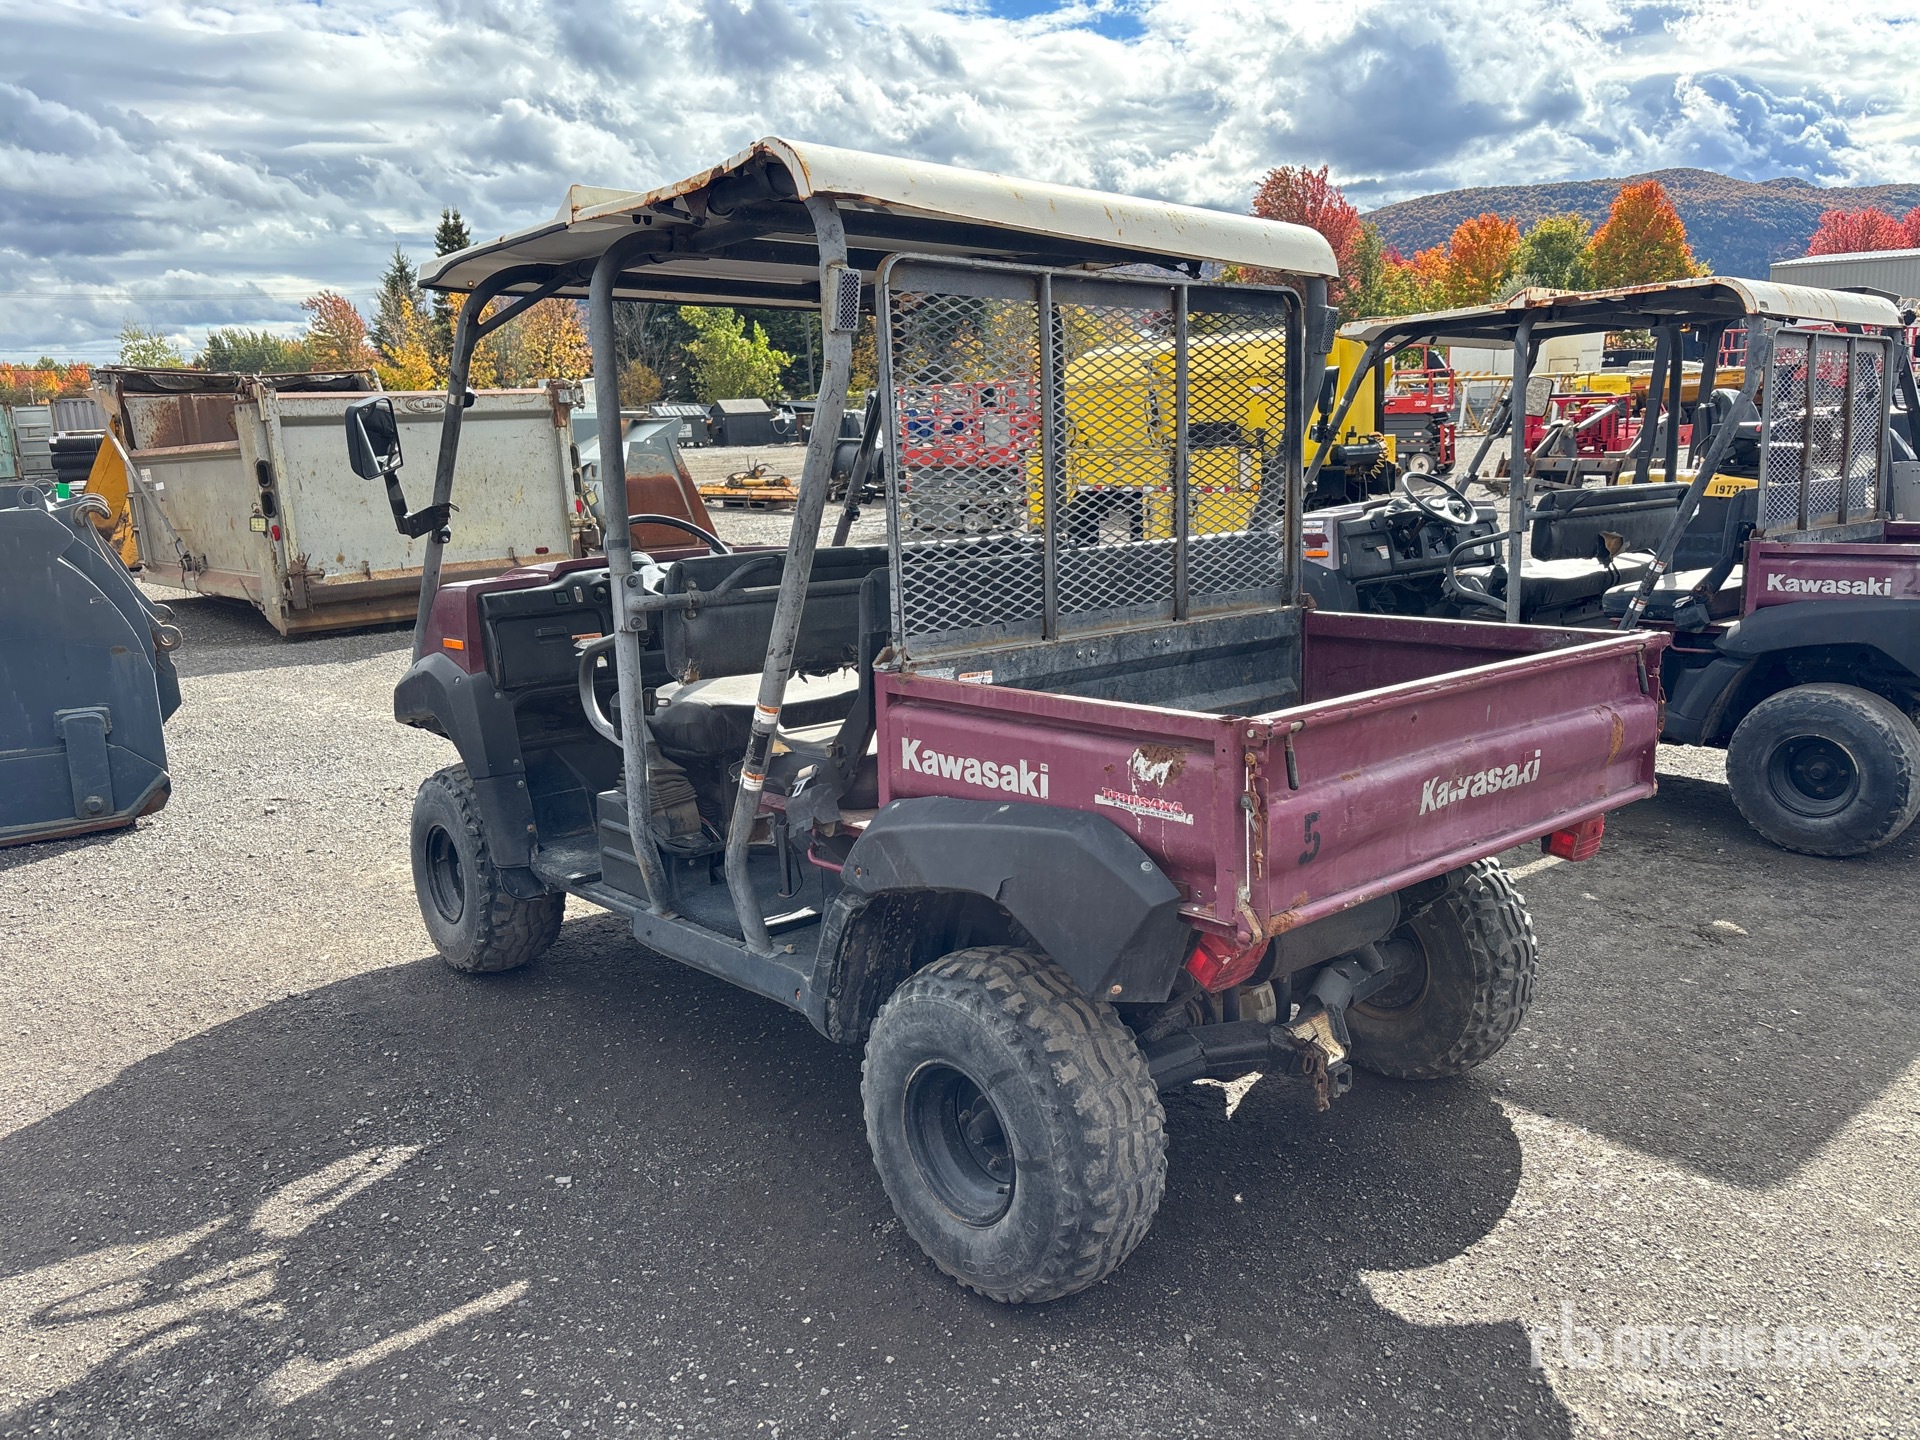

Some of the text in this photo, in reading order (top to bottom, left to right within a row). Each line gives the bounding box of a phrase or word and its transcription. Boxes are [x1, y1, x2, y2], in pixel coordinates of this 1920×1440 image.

[1714, 484, 1747, 495] 1973
[1766, 573, 1892, 596] Kawasaki
[901, 737, 1049, 800] Kawasaki
[1419, 749, 1542, 816] Kawasaki
[1102, 786, 1185, 815] Trans4x4
[1298, 810, 1321, 865] 5
